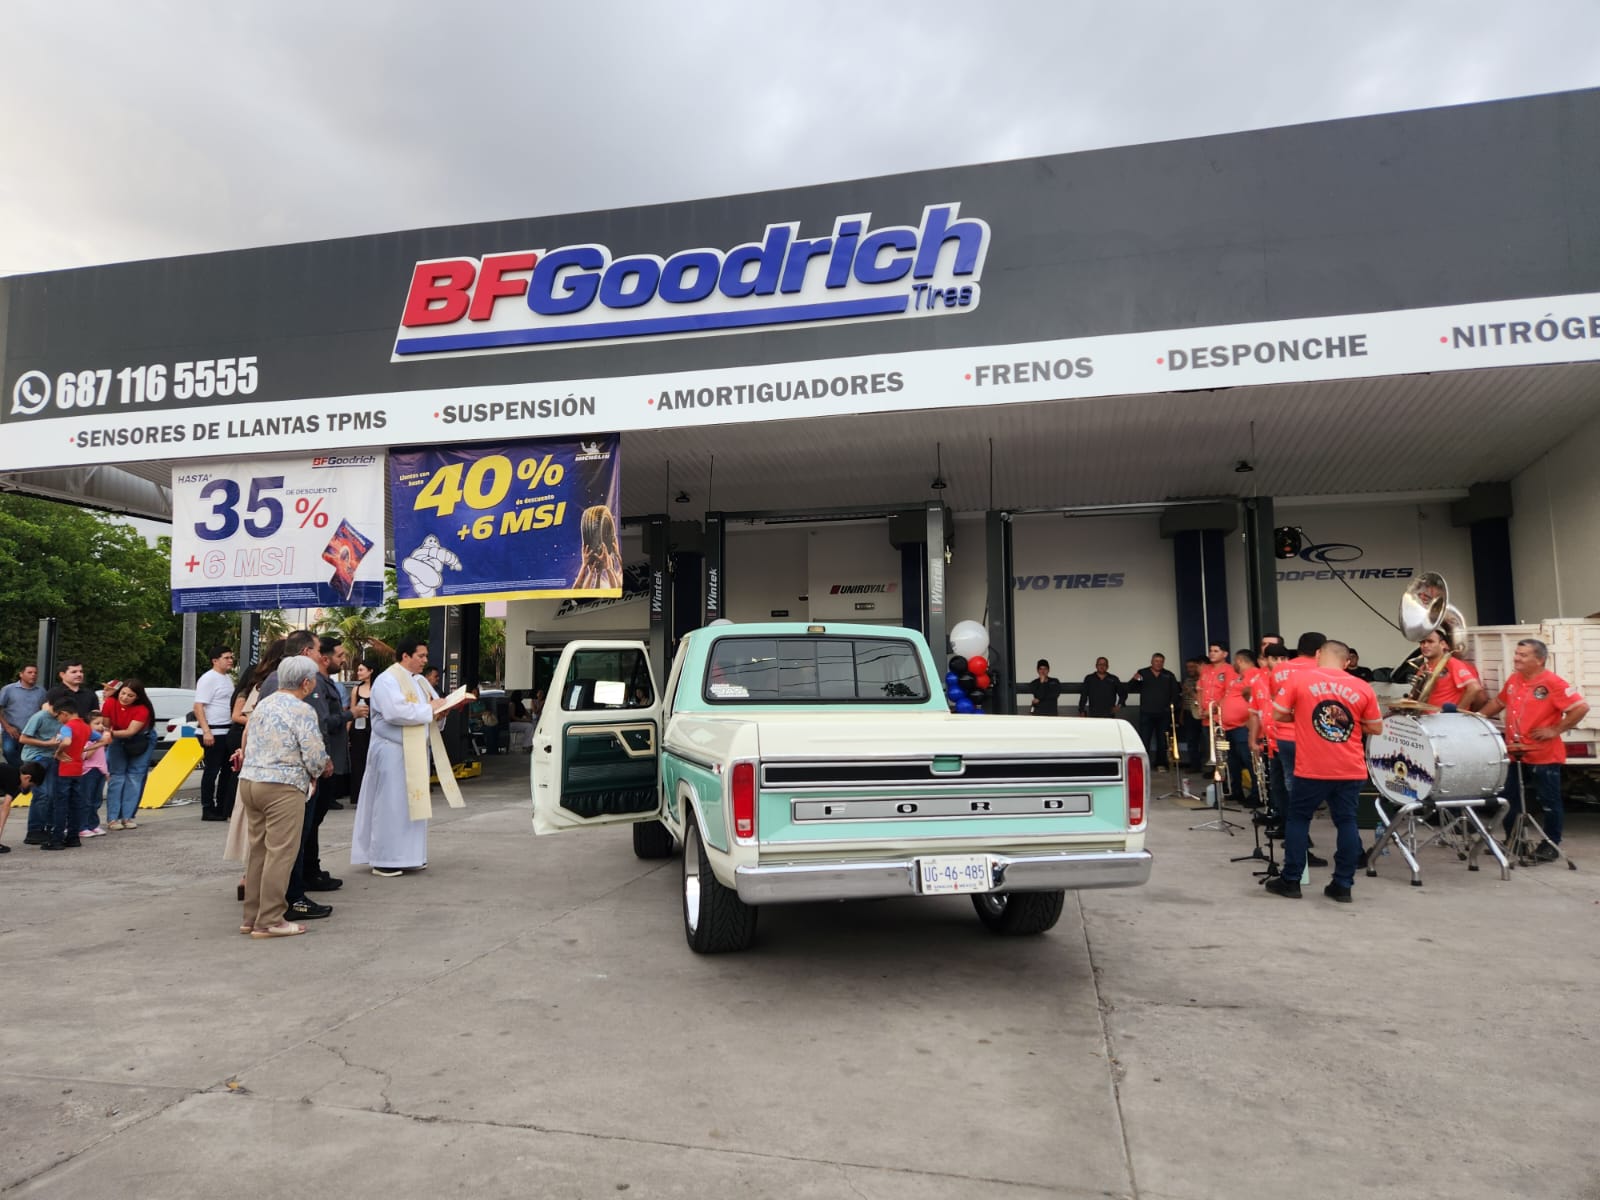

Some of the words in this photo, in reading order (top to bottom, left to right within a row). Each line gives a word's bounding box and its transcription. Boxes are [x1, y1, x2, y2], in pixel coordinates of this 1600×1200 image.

[403, 207, 981, 328] BFGoodrich
[912, 283, 973, 311] Tires
[1168, 334, 1369, 372] DESPONCHE
[56, 369, 112, 409] 687
[117, 364, 168, 404] 116
[174, 356, 258, 400] 5555
[974, 357, 1094, 387] FRENOS
[656, 371, 904, 411] AMORTIGUADORES
[442, 393, 596, 425] SUSPENSIÓN
[76, 425, 187, 448] SENSORES
[193, 422, 220, 441] DE
[227, 414, 320, 438] LLANTAS
[327, 410, 388, 432] TPMS
[312, 455, 376, 467] BFGoodrich
[296, 487, 338, 496] DESCUENTO
[194, 476, 285, 541] 35
[295, 497, 329, 529] %
[457, 515, 495, 541] +6
[499, 501, 567, 536] MSI
[234, 547, 295, 578] MSI
[652, 571, 662, 612] Wintek
[707, 568, 718, 610] Wintek
[840, 584, 886, 594] UNIROYAL
[1010, 575, 1050, 591] YO
[1053, 573, 1125, 589] TIRES
[824, 799, 1064, 816] FORD
[924, 864, 985, 882] UG-46-485
